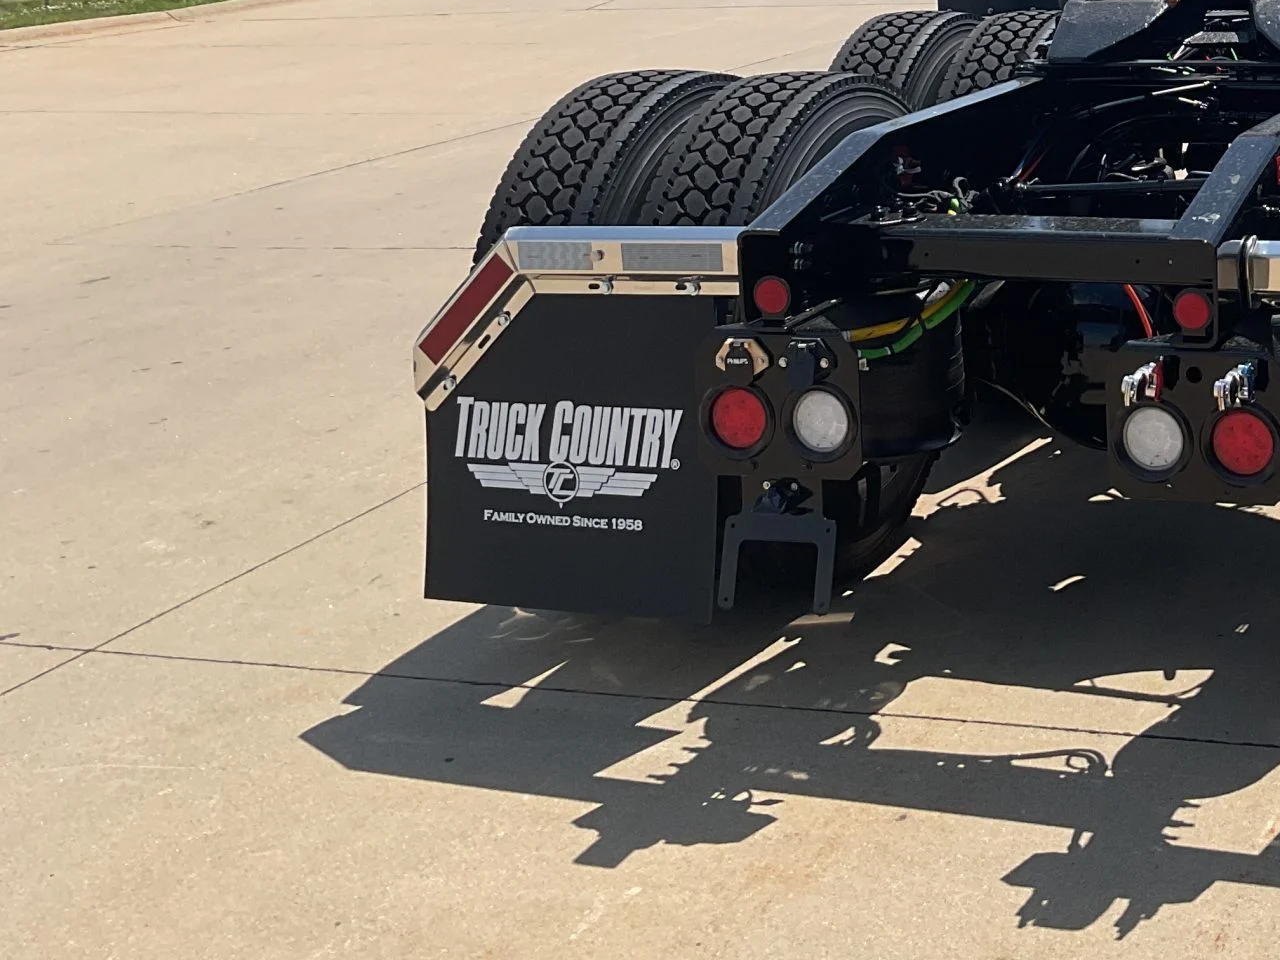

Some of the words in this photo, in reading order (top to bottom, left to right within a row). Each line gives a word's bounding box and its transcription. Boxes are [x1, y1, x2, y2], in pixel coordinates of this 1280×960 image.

[454, 395, 547, 462] TRUCK
[483, 509, 525, 524] FAMILY
[526, 512, 571, 527] OWNED
[572, 515, 609, 530] SINCE
[611, 518, 644, 531] 1958
